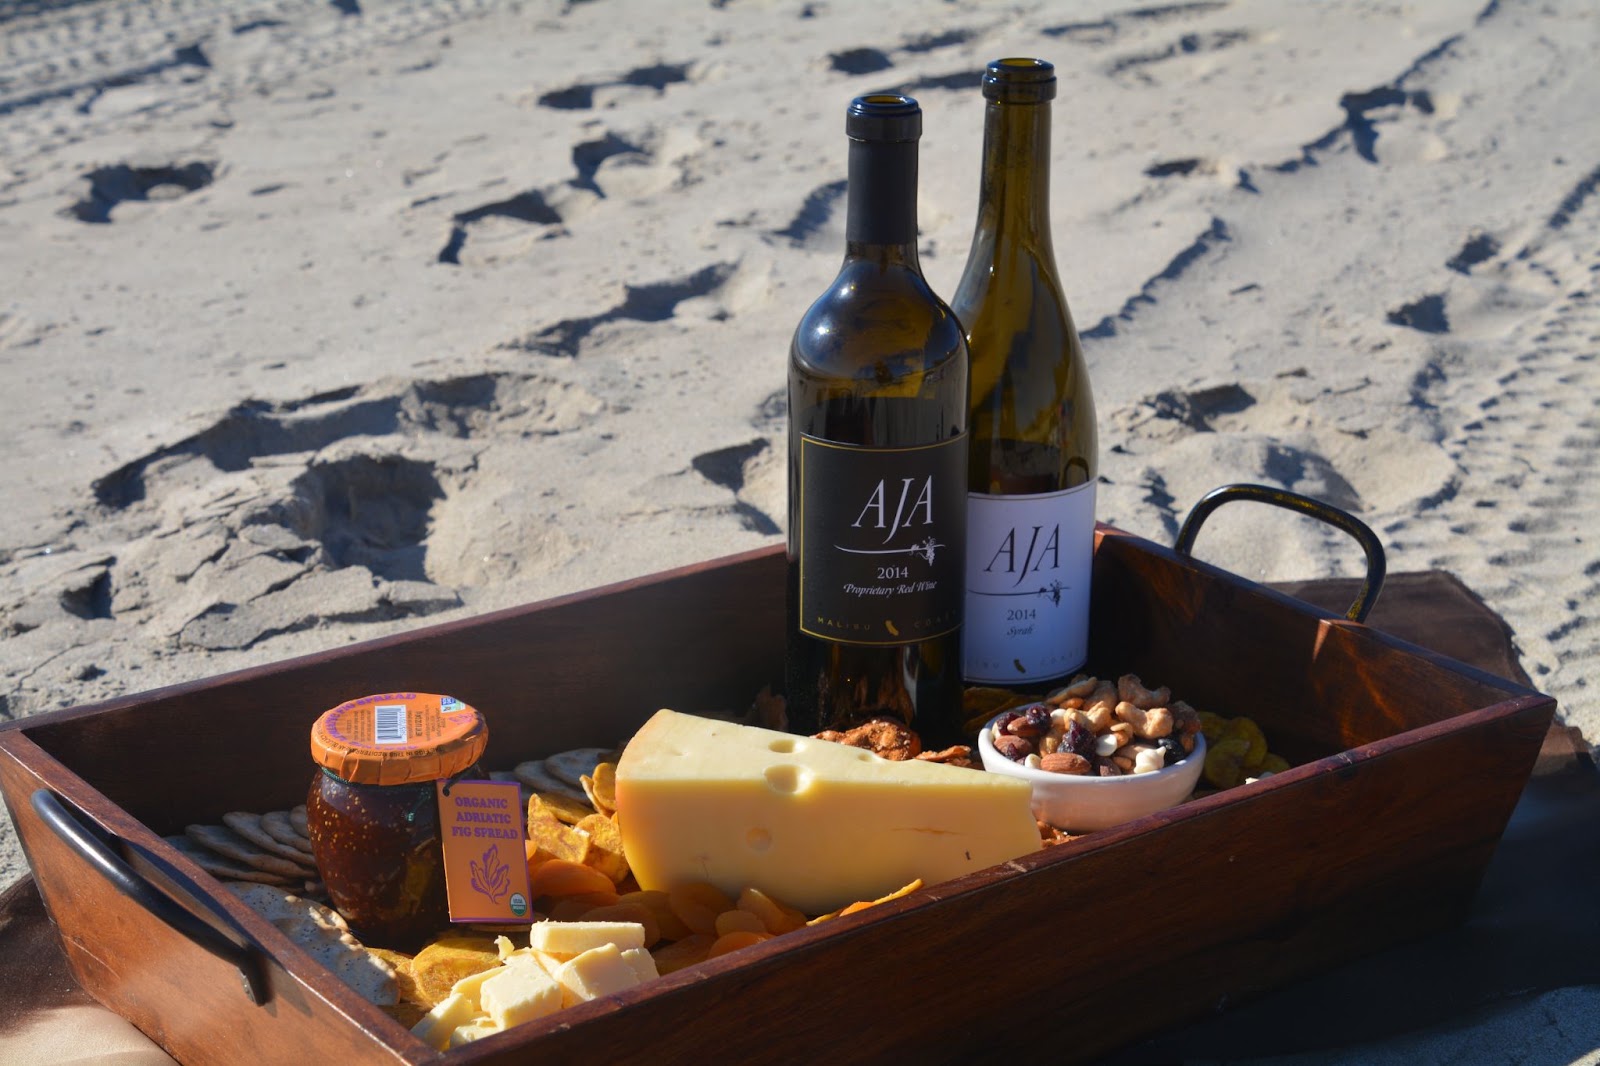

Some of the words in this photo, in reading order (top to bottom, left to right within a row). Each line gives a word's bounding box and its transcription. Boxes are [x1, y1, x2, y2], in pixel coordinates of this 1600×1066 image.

[851, 474, 934, 545] AJA
[983, 523, 1060, 588] AJA
[877, 566, 909, 579] 2014
[843, 583, 895, 598] Proprietary
[896, 581, 916, 594] Red
[916, 580, 938, 592] Wine
[1007, 608, 1036, 621] 2014
[1006, 623, 1034, 638] Syrah
[357, 692, 417, 706] SPREAD
[455, 796, 508, 809] ORGANIC
[456, 812, 511, 824] ADRIATIC
[452, 826, 472, 837] FIG
[474, 828, 518, 839] SPREAD
